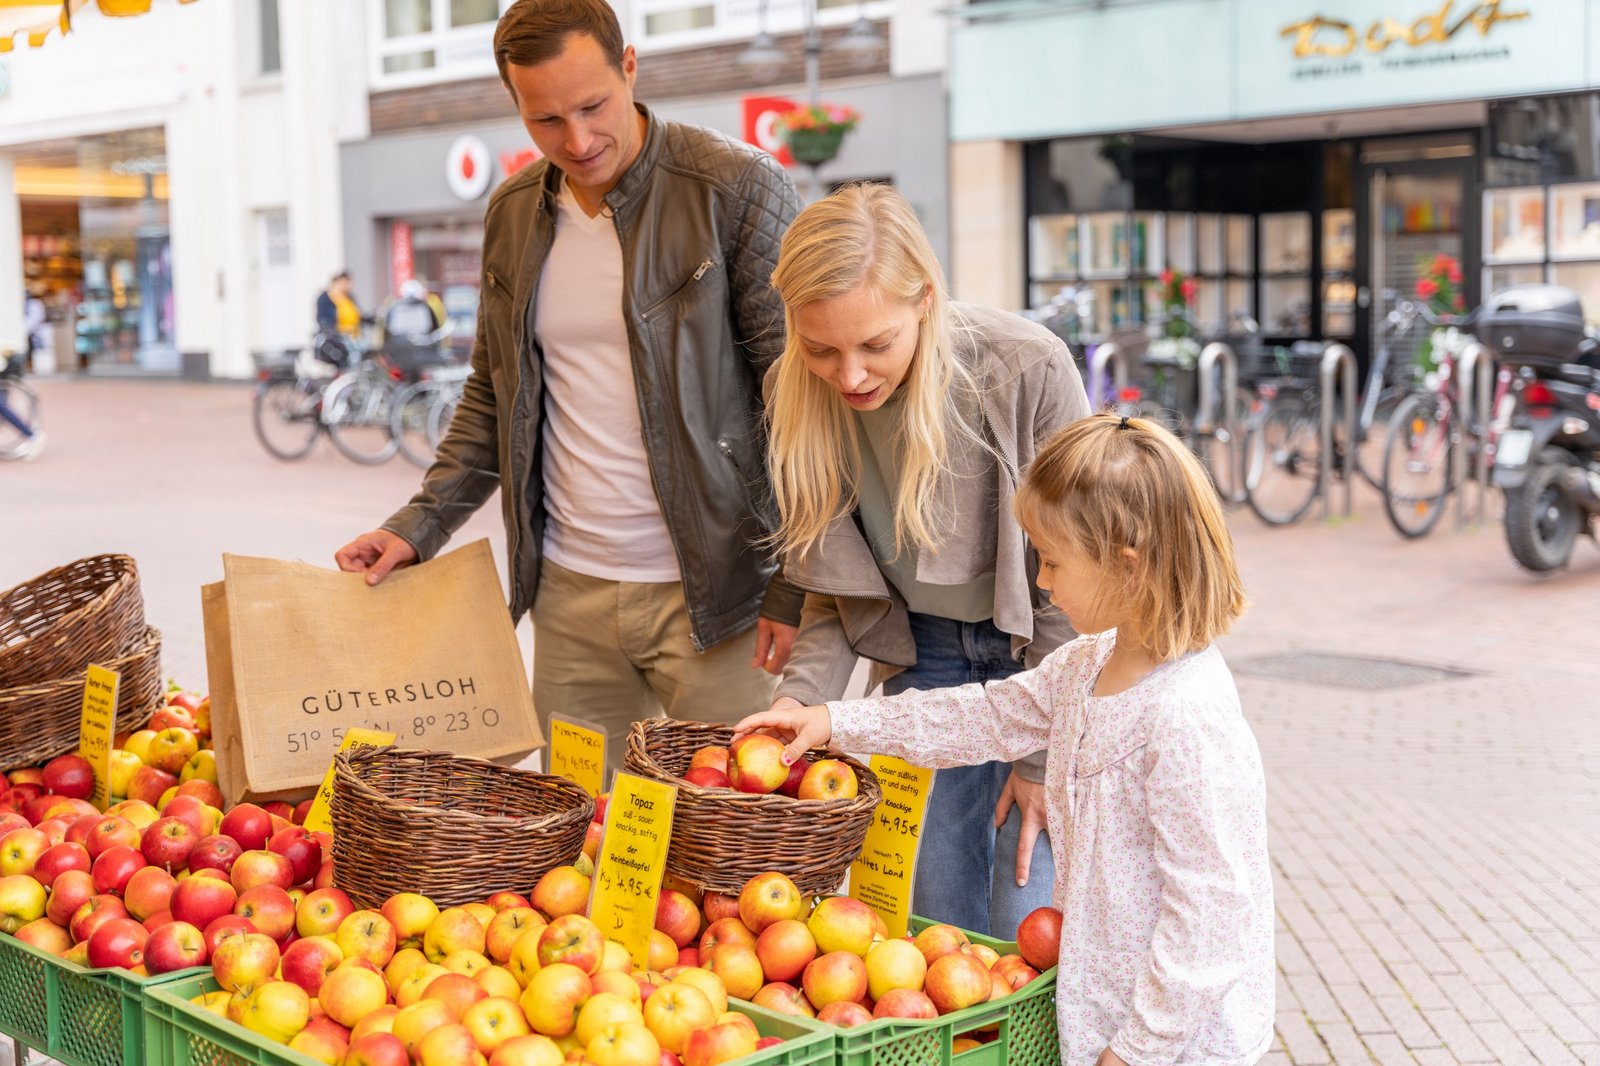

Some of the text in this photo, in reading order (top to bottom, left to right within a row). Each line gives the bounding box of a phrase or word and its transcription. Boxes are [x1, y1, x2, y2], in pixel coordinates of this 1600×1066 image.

[302, 677, 477, 715] GÜTERSLOH
[879, 765, 919, 782] Sauer süßlich
[887, 780, 899, 789] und
[900, 785, 919, 796] saftig
[630, 793, 655, 810] Topaz
[884, 798, 912, 813] Knackige
[623, 811, 634, 819] süß
[638, 816, 655, 825] sauer
[880, 814, 919, 837] 4,95€
[639, 829, 658, 842] saftig
[626, 845, 638, 854] der
[610, 853, 650, 872] Reinbeißapfel
[600, 867, 653, 899] Kg 4,95€
